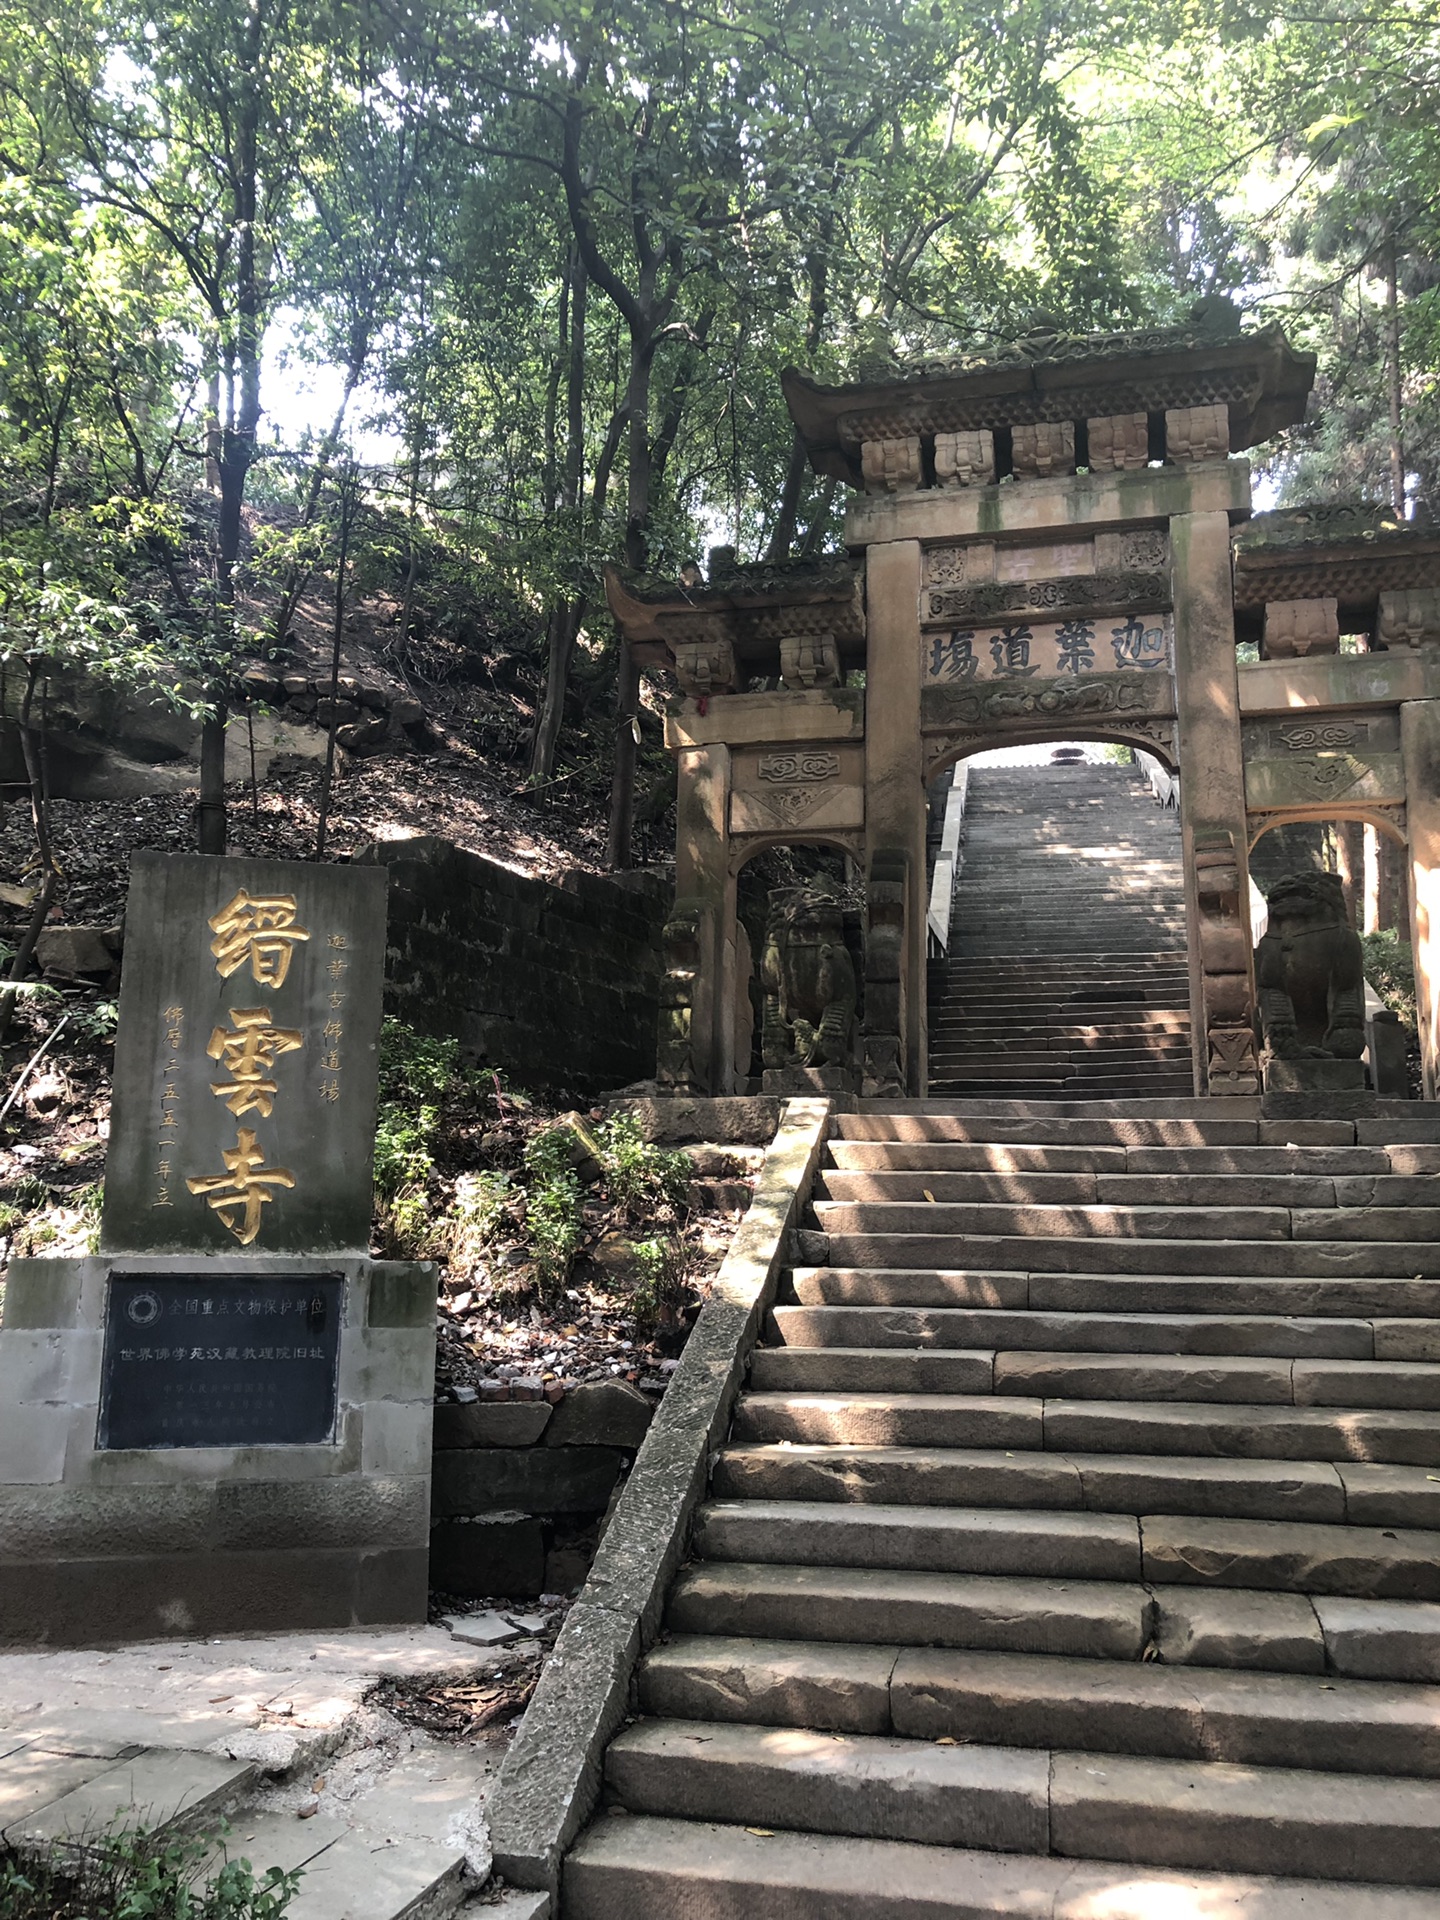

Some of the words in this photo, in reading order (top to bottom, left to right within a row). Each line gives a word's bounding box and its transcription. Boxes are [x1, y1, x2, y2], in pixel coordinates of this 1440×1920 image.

[185, 887, 311, 1245] 縉雲寺
[168, 1298, 325, 1316] 全国重点文物保护单位
[119, 1346, 326, 1361] 世界佛学苑汉藏教理院旧址
